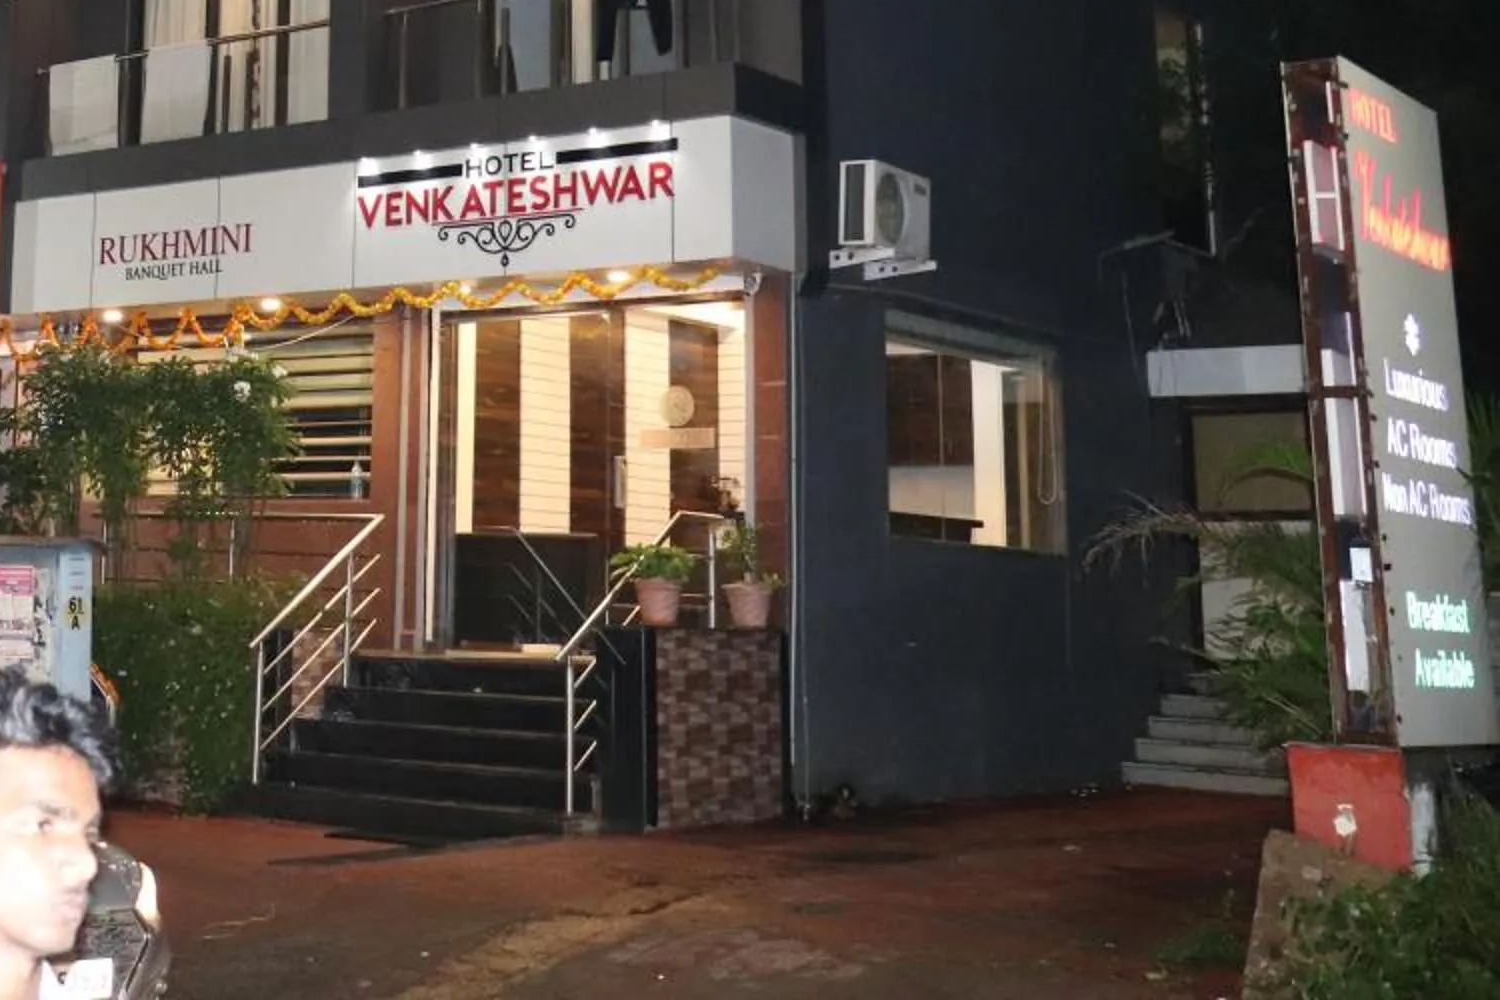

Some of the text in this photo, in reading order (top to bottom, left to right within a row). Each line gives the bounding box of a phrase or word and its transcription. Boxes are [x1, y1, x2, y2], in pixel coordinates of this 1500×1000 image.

[465, 152, 555, 178] HOTEL
[358, 161, 676, 229] VENKATESHWAR
[100, 223, 252, 265] RUKHMINI
[125, 259, 223, 281] BANQUET HALL
[1387, 416, 1457, 469] AC Rooms
